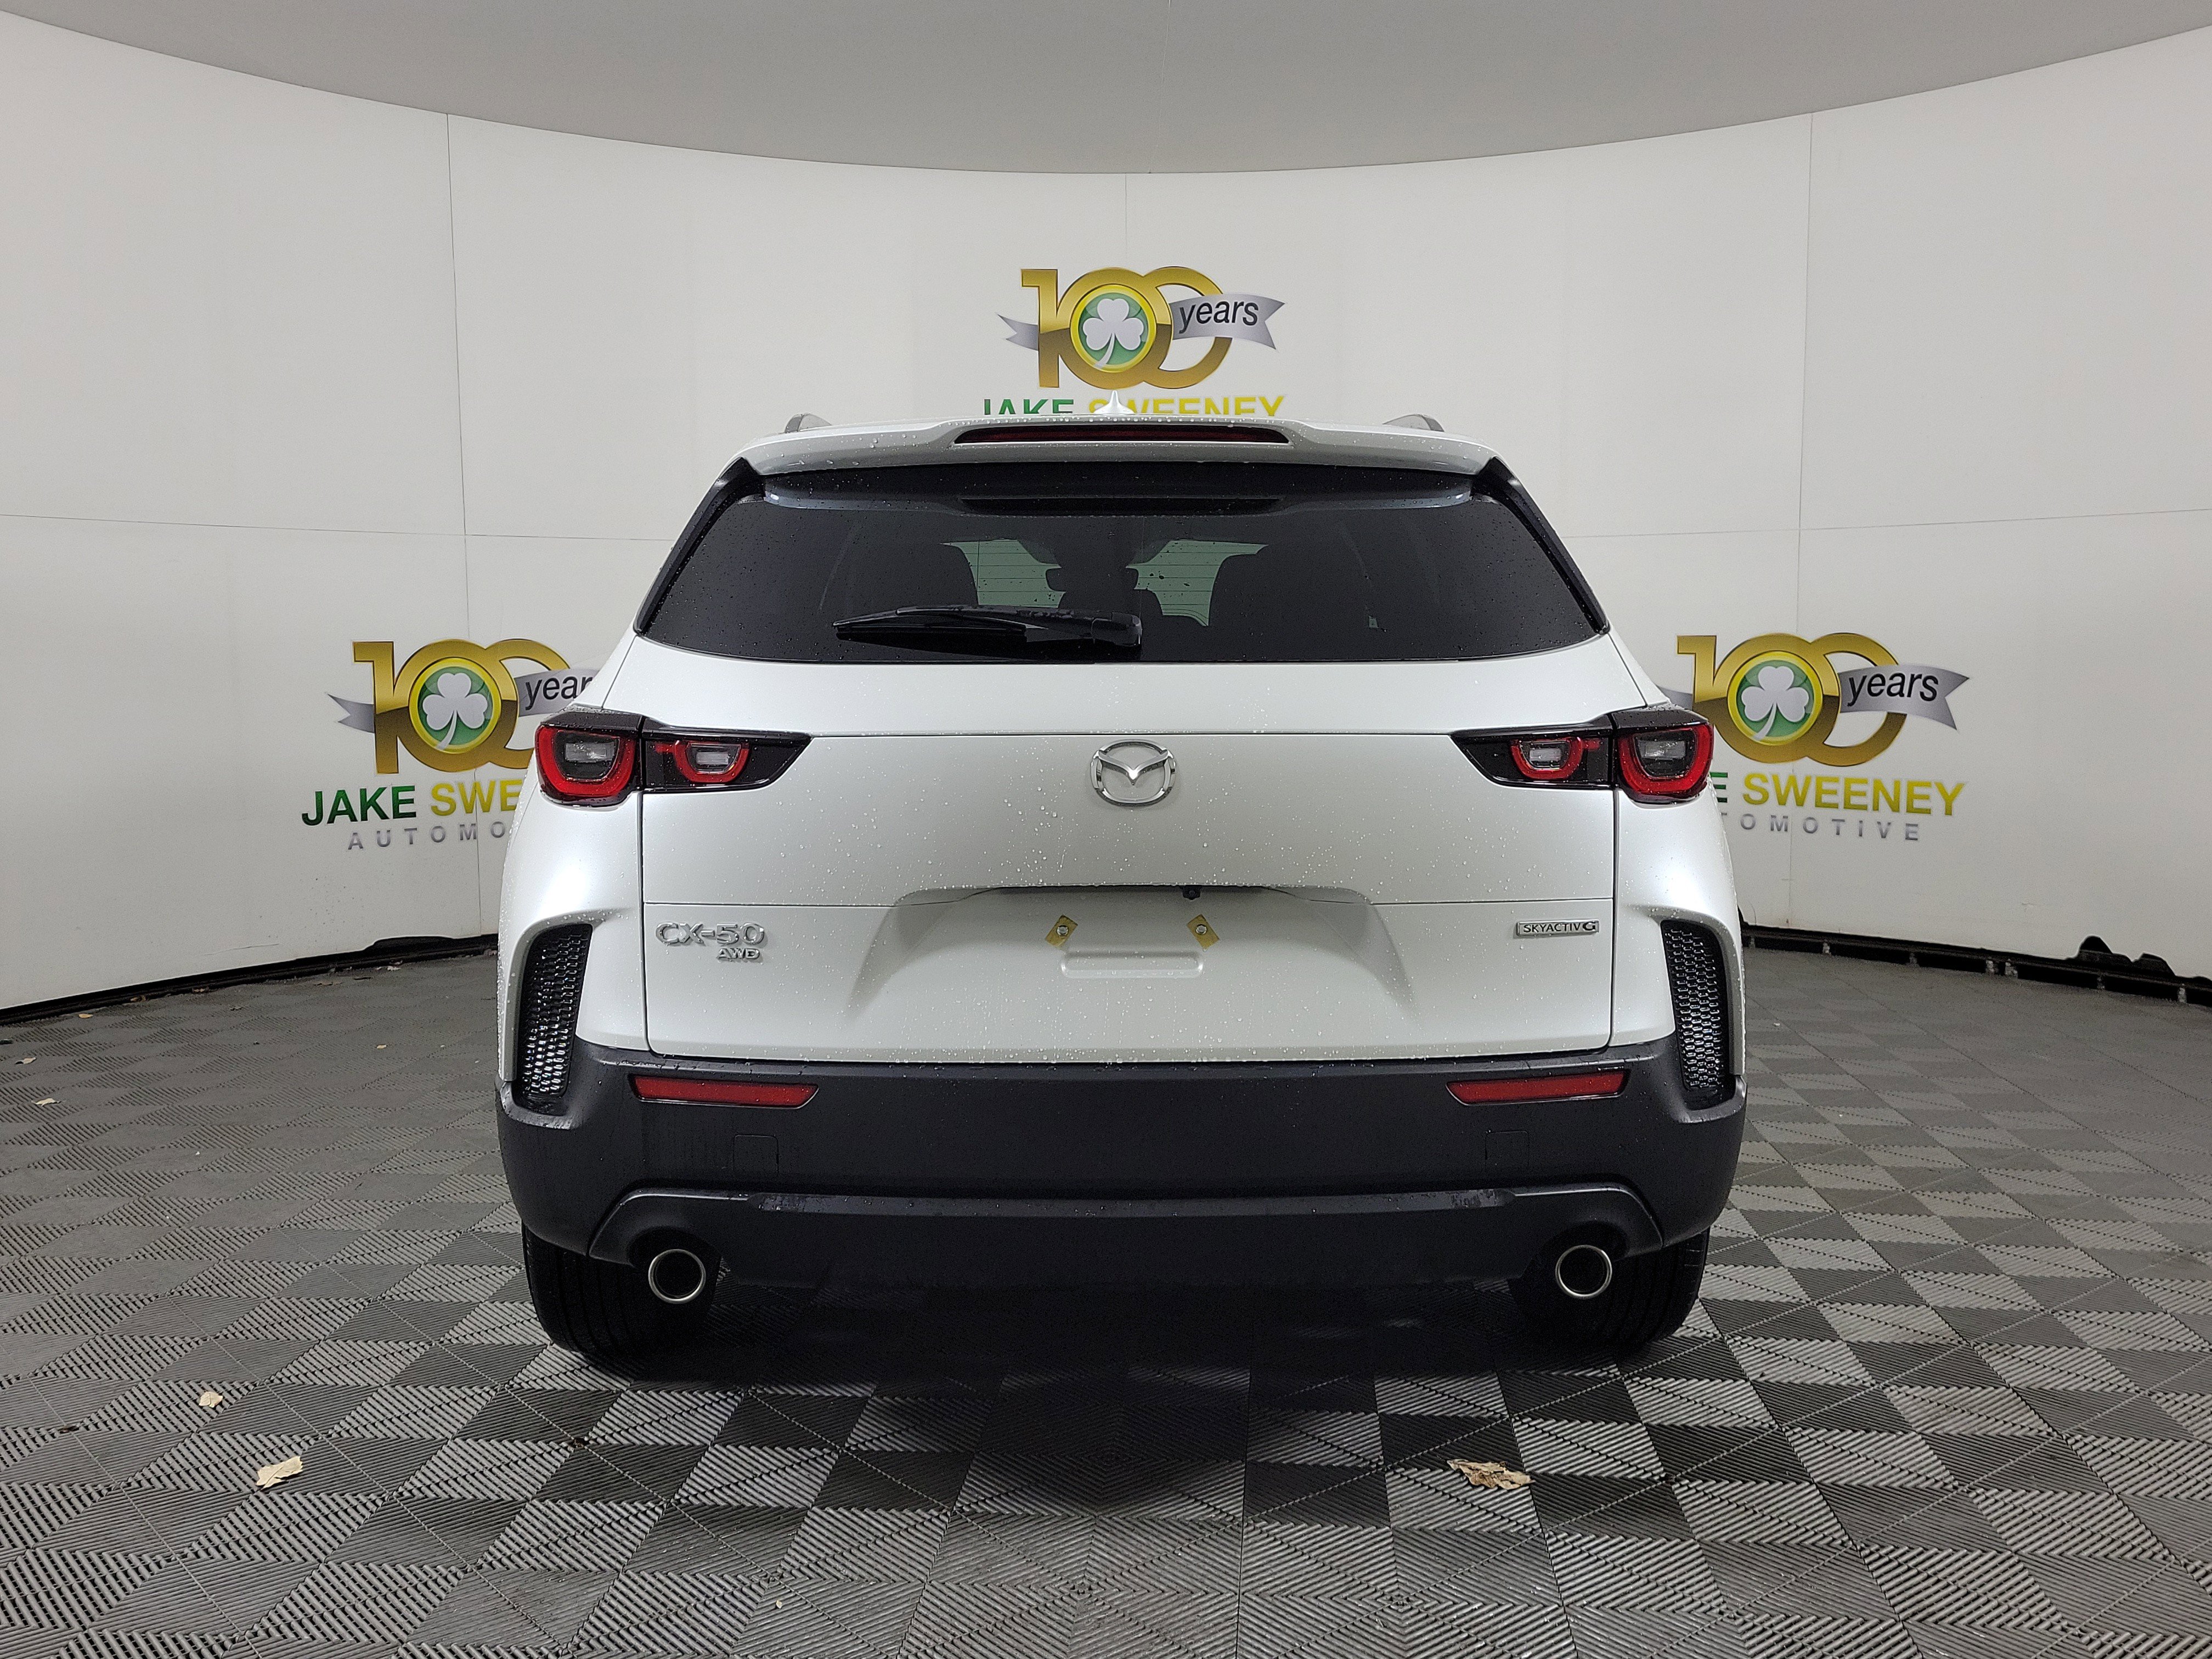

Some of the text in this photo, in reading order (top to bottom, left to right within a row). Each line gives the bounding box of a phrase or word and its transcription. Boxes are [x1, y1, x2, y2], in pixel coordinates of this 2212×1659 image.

[1020, 266, 1233, 389] 100
[1179, 300, 1259, 334] years
[1089, 396, 1284, 416] EENEY
[352, 639, 571, 774] 100
[525, 676, 593, 710] year
[1677, 633, 1908, 766] 100
[1847, 672, 1939, 707] years
[301, 785, 417, 826] JAKE
[1742, 772, 1965, 816] SWEENEY
[347, 821, 505, 850] AUTOMO
[1721, 812, 1919, 841] OMOTIVE
[656, 922, 765, 945] CX-50
[716, 948, 761, 960] AWD
